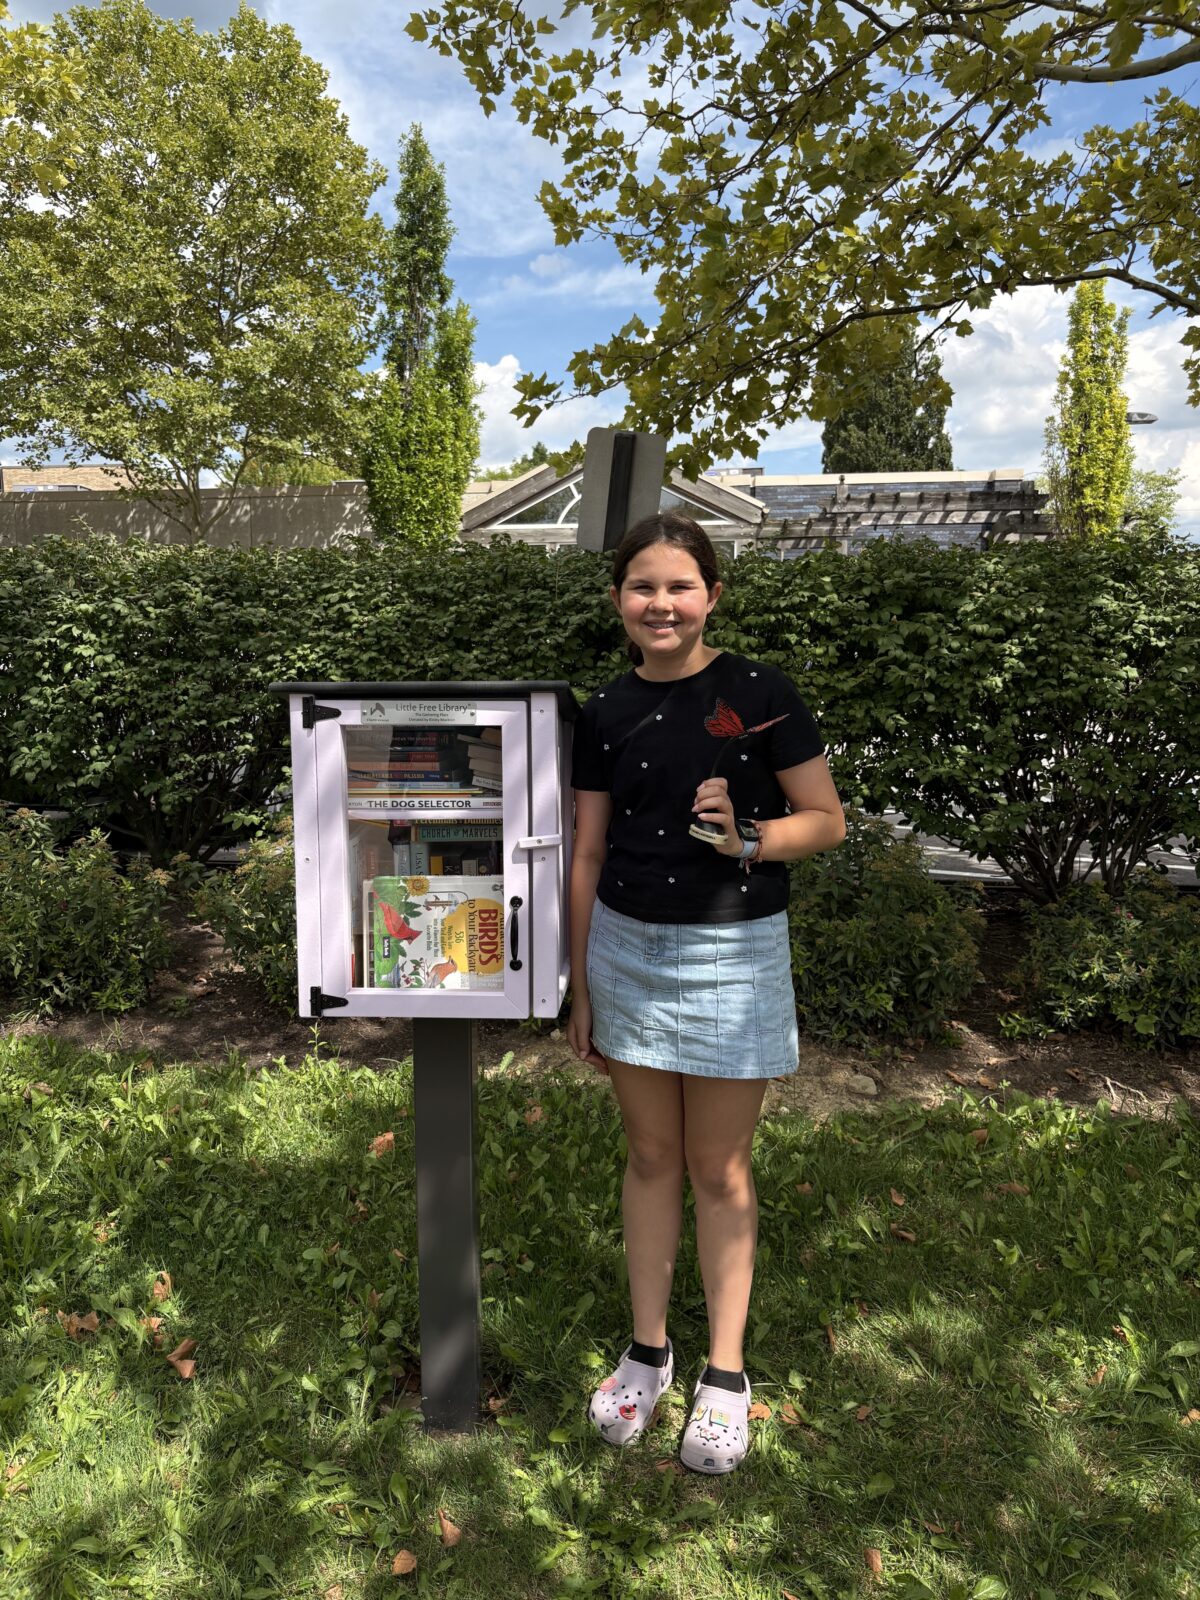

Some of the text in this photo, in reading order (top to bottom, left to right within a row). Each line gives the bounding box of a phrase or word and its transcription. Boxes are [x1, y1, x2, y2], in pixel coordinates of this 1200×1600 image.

[396, 703, 468, 714] Little Free Library
[368, 800, 472, 808] THE DOG SELECTOR
[421, 827, 451, 838] CHURCH
[462, 827, 498, 838] MARVELS
[467, 899, 476, 909] to
[468, 910, 478, 933] Your
[455, 931, 464, 944] 536
[478, 908, 499, 966] BIRDS
